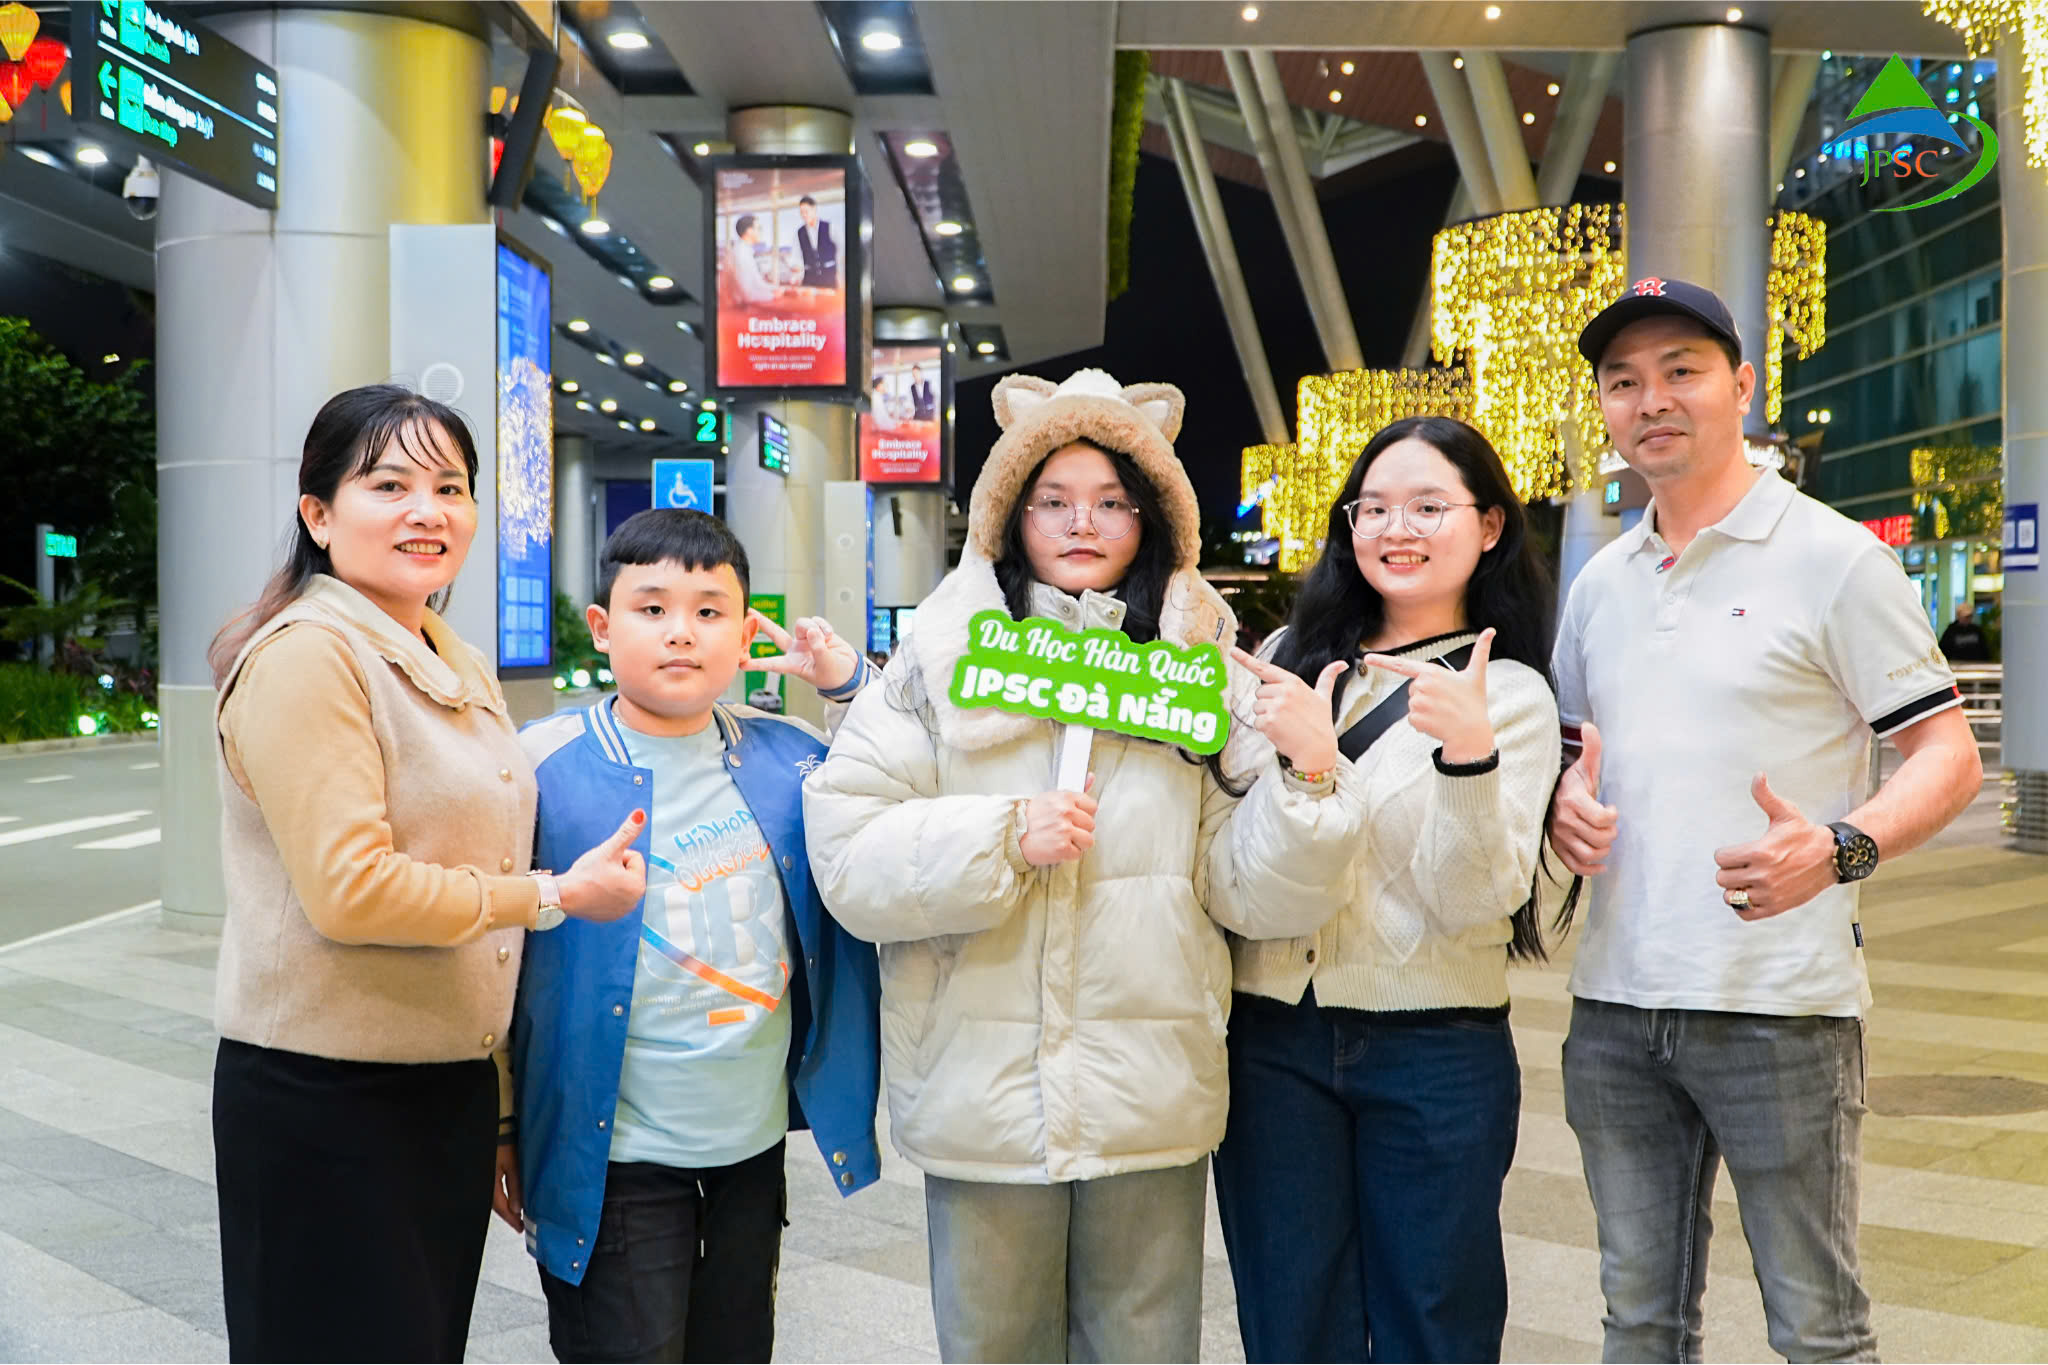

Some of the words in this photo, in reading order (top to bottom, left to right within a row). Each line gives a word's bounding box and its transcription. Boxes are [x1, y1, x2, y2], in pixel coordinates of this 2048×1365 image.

[748, 317, 817, 333] Embrace
[737, 332, 827, 352] Hospitality
[697, 412, 717, 441] 2
[878, 438, 922, 449] Embrace
[871, 449, 929, 463] Hospitality
[979, 619, 1019, 651] Du
[1026, 627, 1076, 664] Học
[1083, 638, 1142, 675] Hàn
[1148, 650, 1217, 687] Quốc
[1056, 682, 1110, 719] Đà
[1118, 687, 1218, 744] Nẵng
